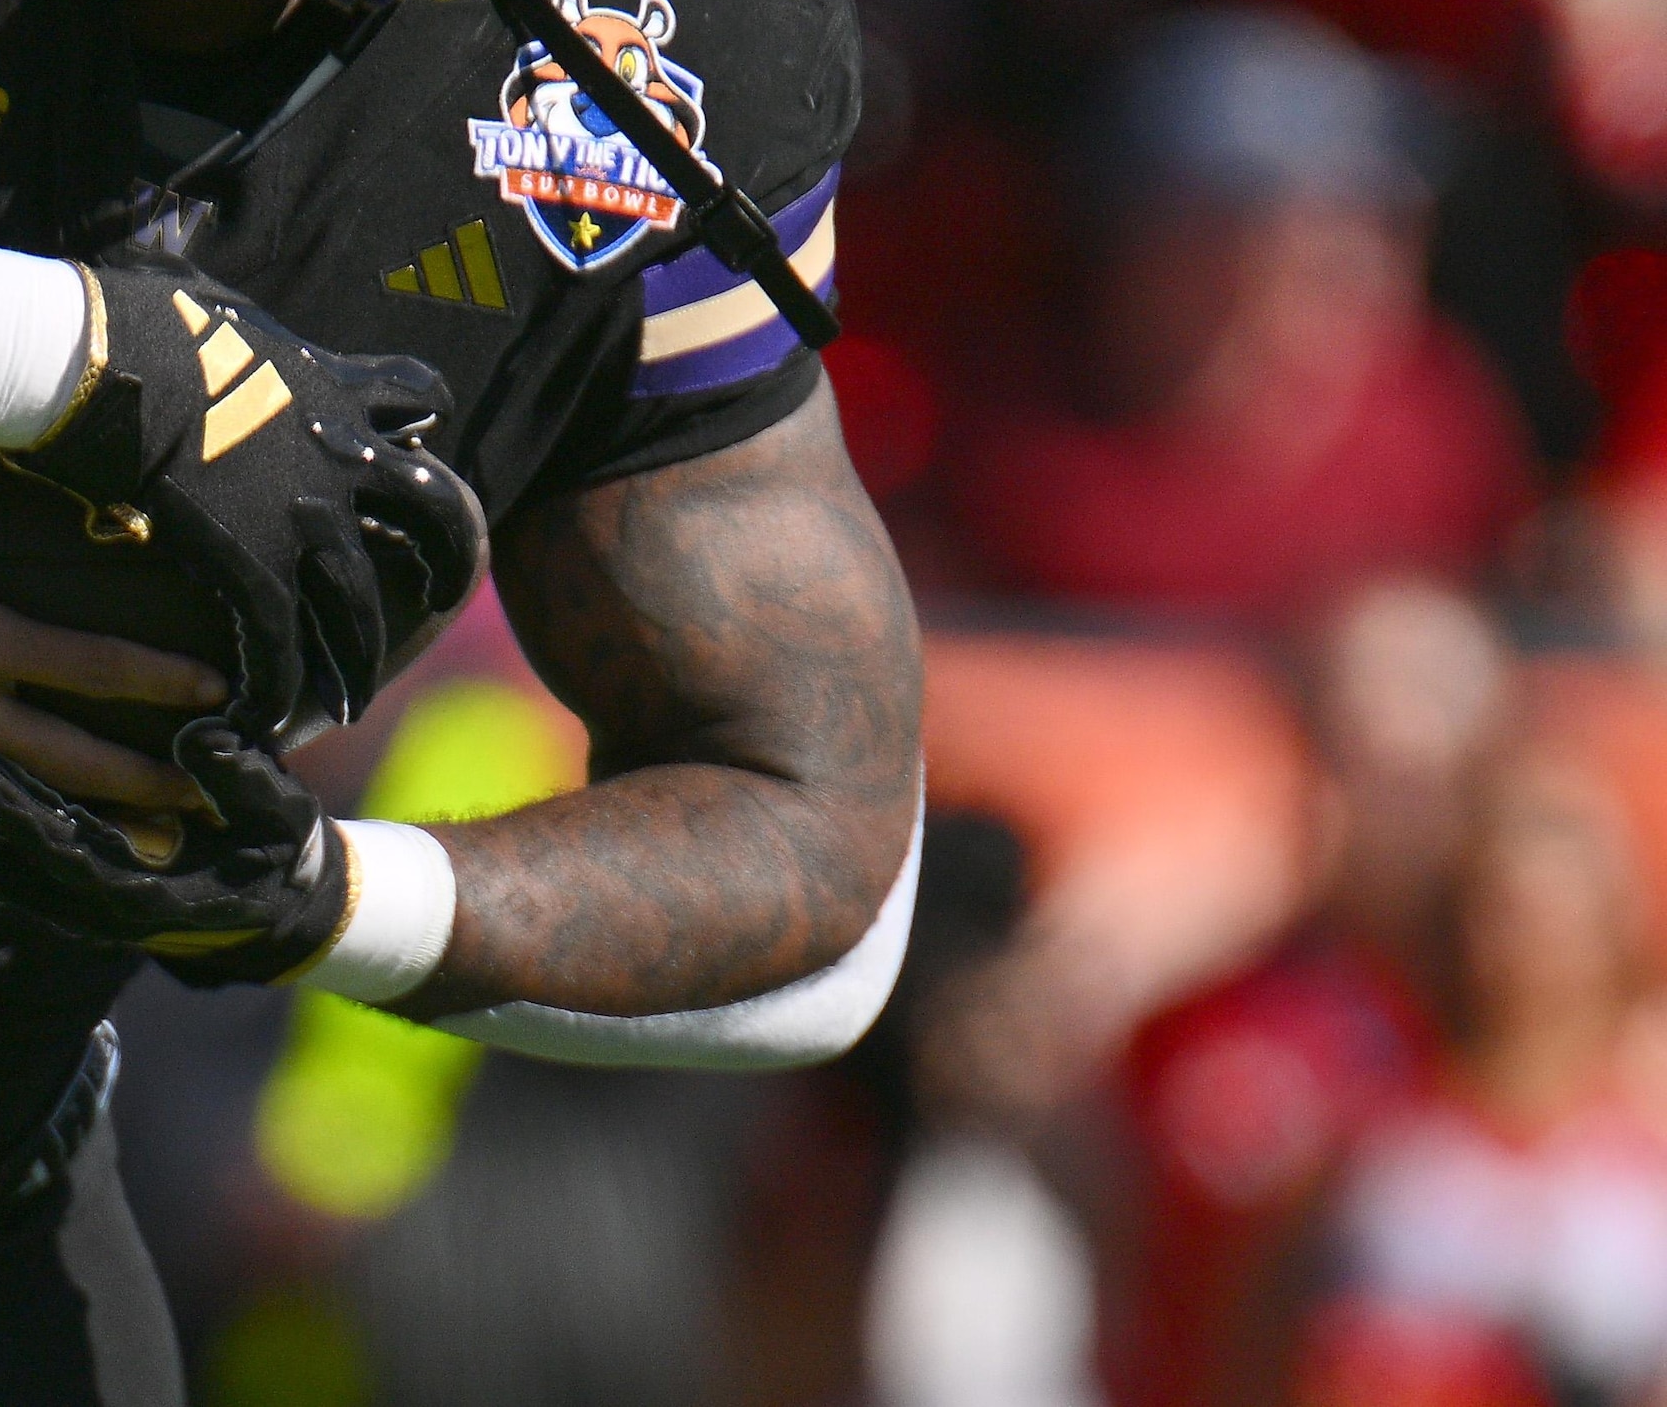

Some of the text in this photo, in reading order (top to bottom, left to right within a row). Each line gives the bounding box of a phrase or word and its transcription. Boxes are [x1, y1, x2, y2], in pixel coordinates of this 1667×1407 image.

[477, 127, 571, 171] TONY
[575, 137, 616, 168] THE
[520, 172, 575, 197] SUN
[584, 182, 658, 214] BOWL
